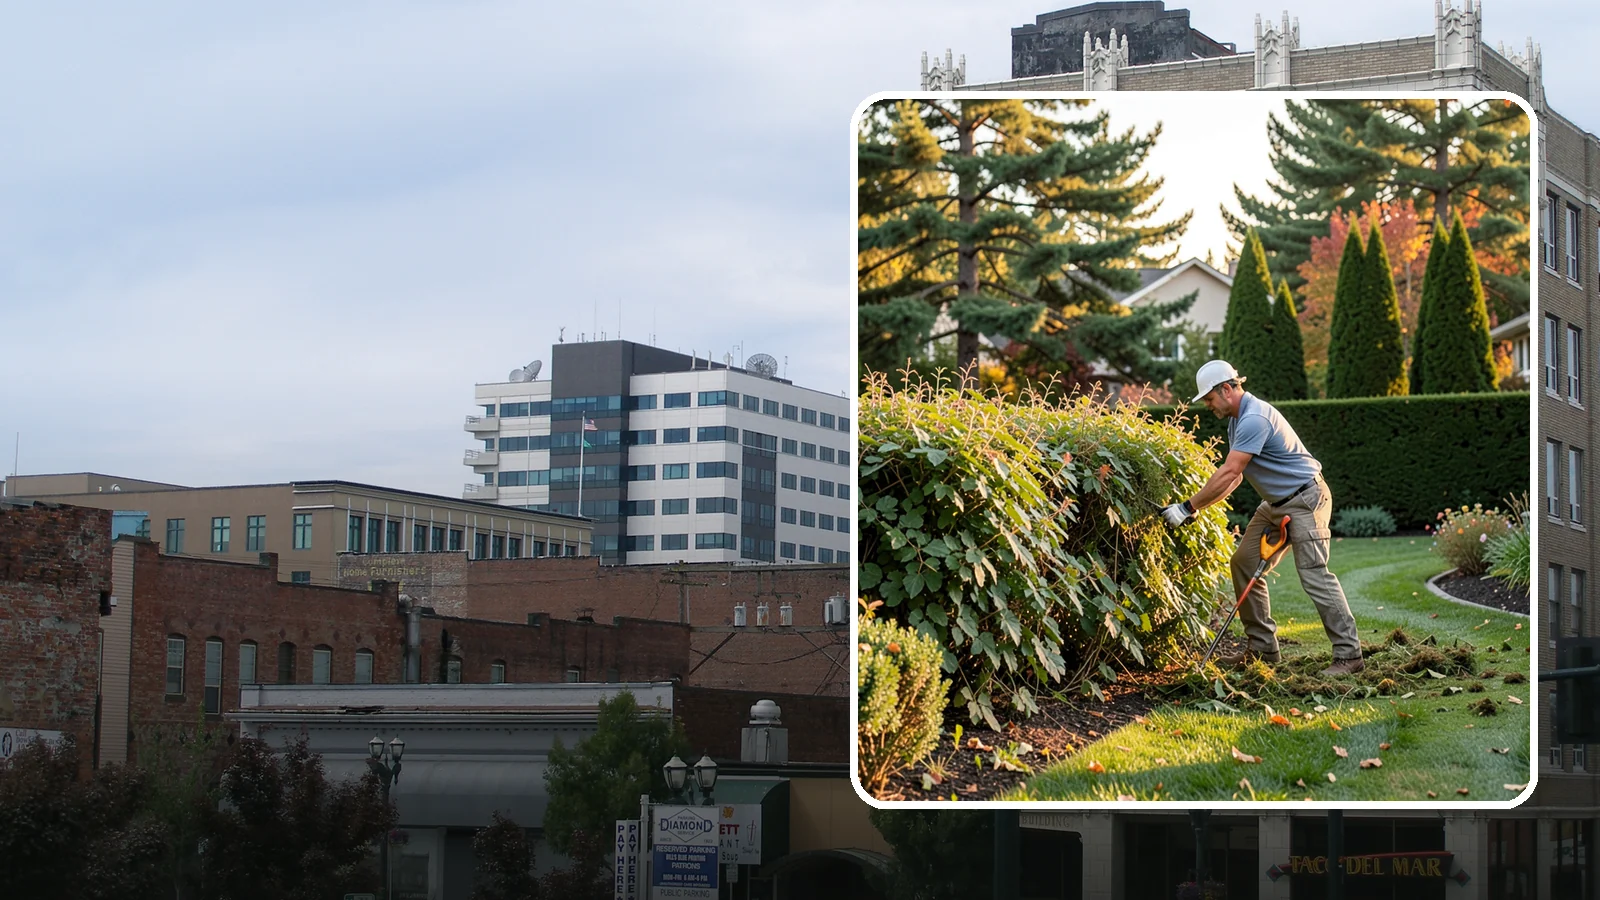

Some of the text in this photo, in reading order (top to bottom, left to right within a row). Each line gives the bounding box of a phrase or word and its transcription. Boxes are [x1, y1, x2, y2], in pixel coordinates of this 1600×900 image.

[660, 818, 713, 832] DIAMOND
[1022, 815, 1070, 828] BUILDING
[656, 845, 716, 854] RESERVED PARKING
[627, 824, 636, 893] PAY HERE
[671, 862, 700, 870] PATRONS
[1289, 855, 1442, 877] TAC DEL MAR
[616, 855, 624, 893] HERE
[660, 888, 710, 898] PUBLIC PARKING
